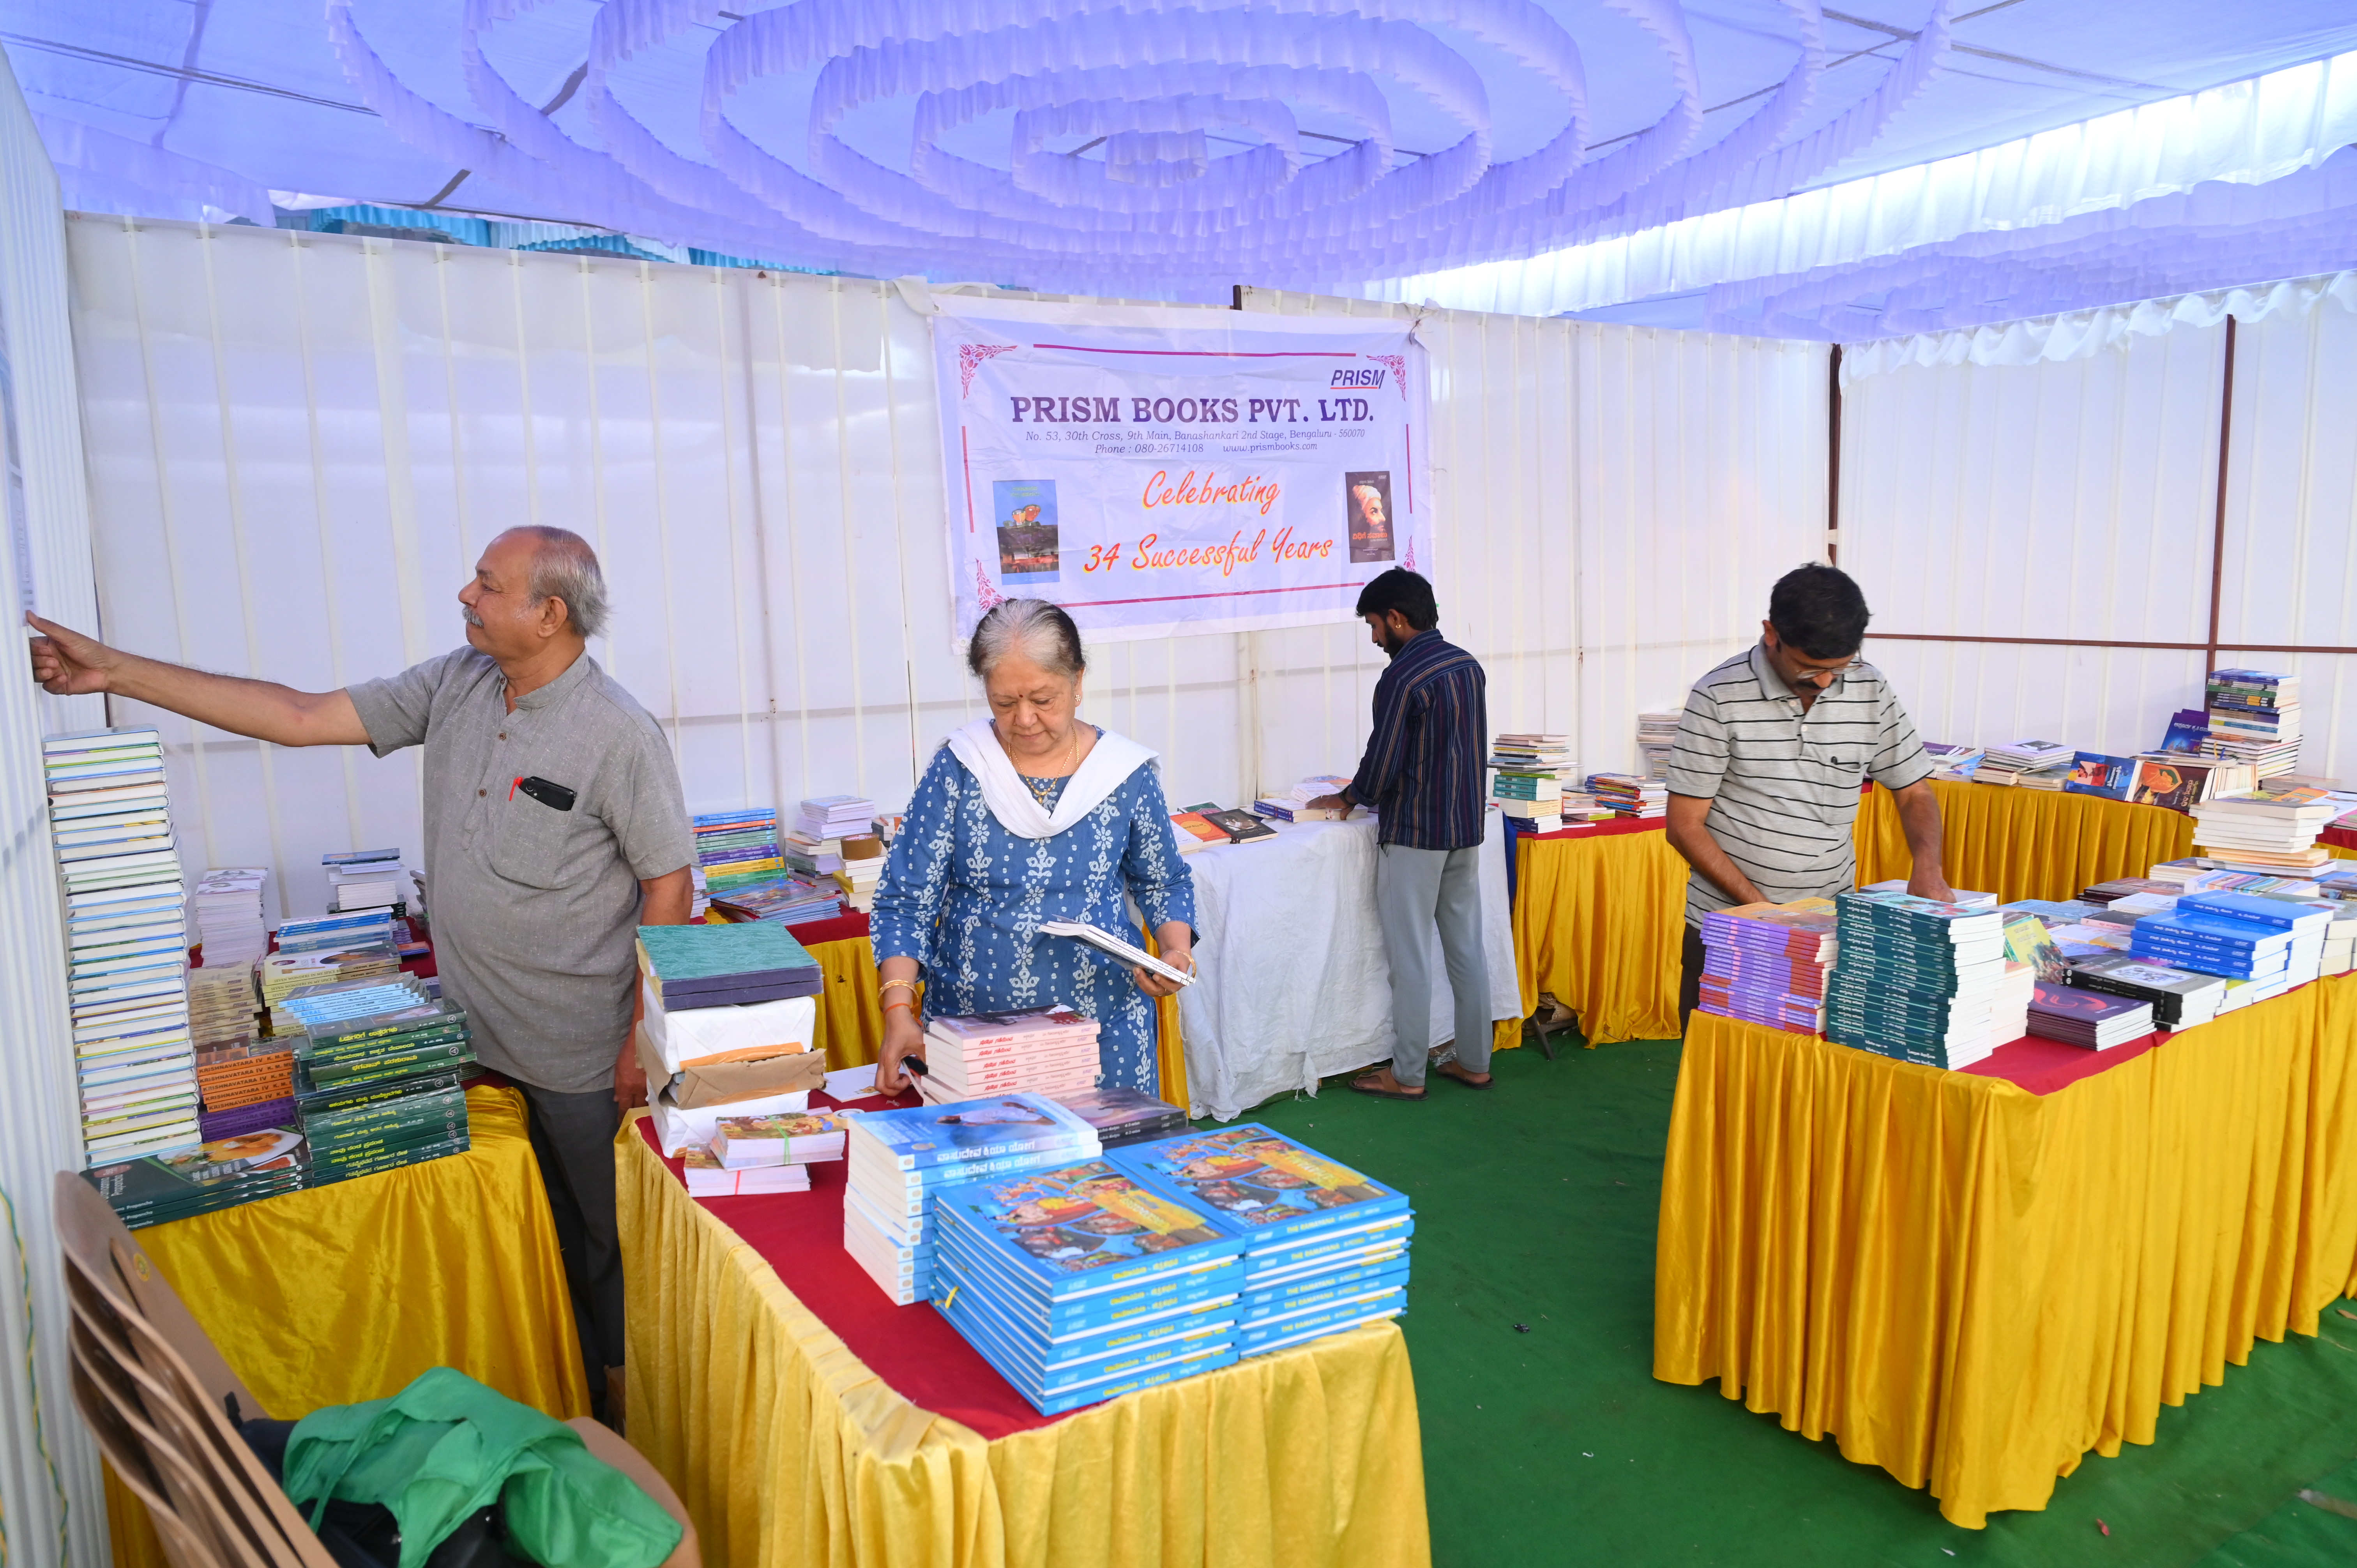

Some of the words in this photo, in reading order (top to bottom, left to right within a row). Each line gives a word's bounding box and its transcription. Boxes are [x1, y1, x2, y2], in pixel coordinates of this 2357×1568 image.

[1331, 369, 1385, 389] PRISM
[1011, 397, 1121, 422] PRISM
[1132, 397, 1239, 423] BOOKS
[1249, 398, 1309, 422] PVT.
[1318, 398, 1373, 422] LTD.
[1026, 431, 1042, 441] No.
[1046, 431, 1061, 442] 53,
[1065, 431, 1088, 441] 30th
[1092, 431, 1123, 441] Cross,
[1127, 431, 1143, 440] 9th
[1146, 431, 1171, 441] Main,
[1175, 430, 1239, 440] Banashankari
[1241, 430, 1257, 440] 2nd
[1260, 430, 1286, 441] Stage,
[1290, 429, 1332, 440] Bengaluru
[1338, 429, 1365, 438] 560070
[1095, 444, 1125, 454] Phone
[1134, 443, 1203, 453] 080-26714108
[1223, 442, 1318, 453] www.prismbooks.com
[1142, 470, 1281, 516] Celebrating
[1083, 543, 1121, 573] 34
[1131, 528, 1266, 577] Successful
[1271, 526, 1333, 564] Years
[199, 1060, 253, 1073] KRISHNAVATARA
[200, 1070, 254, 1083] KRISHNAVATARA
[203, 1078, 257, 1092] KRISHNAVATARA
[205, 1087, 259, 1101] KRISHNAVATARA
[209, 1096, 263, 1110] KRISHNAVATARA
[936, 1147, 982, 1162] ವಾಸುದೇವ
[1008, 1141, 1035, 1152] ಯೋಗ
[943, 1163, 988, 1178] ವಾಸುದೇವ
[1014, 1155, 1041, 1167] ಯೋಗ
[127, 1201, 153, 1210] Prapancha
[127, 1211, 153, 1219] Prapancha
[127, 1220, 153, 1229] Prapancha
